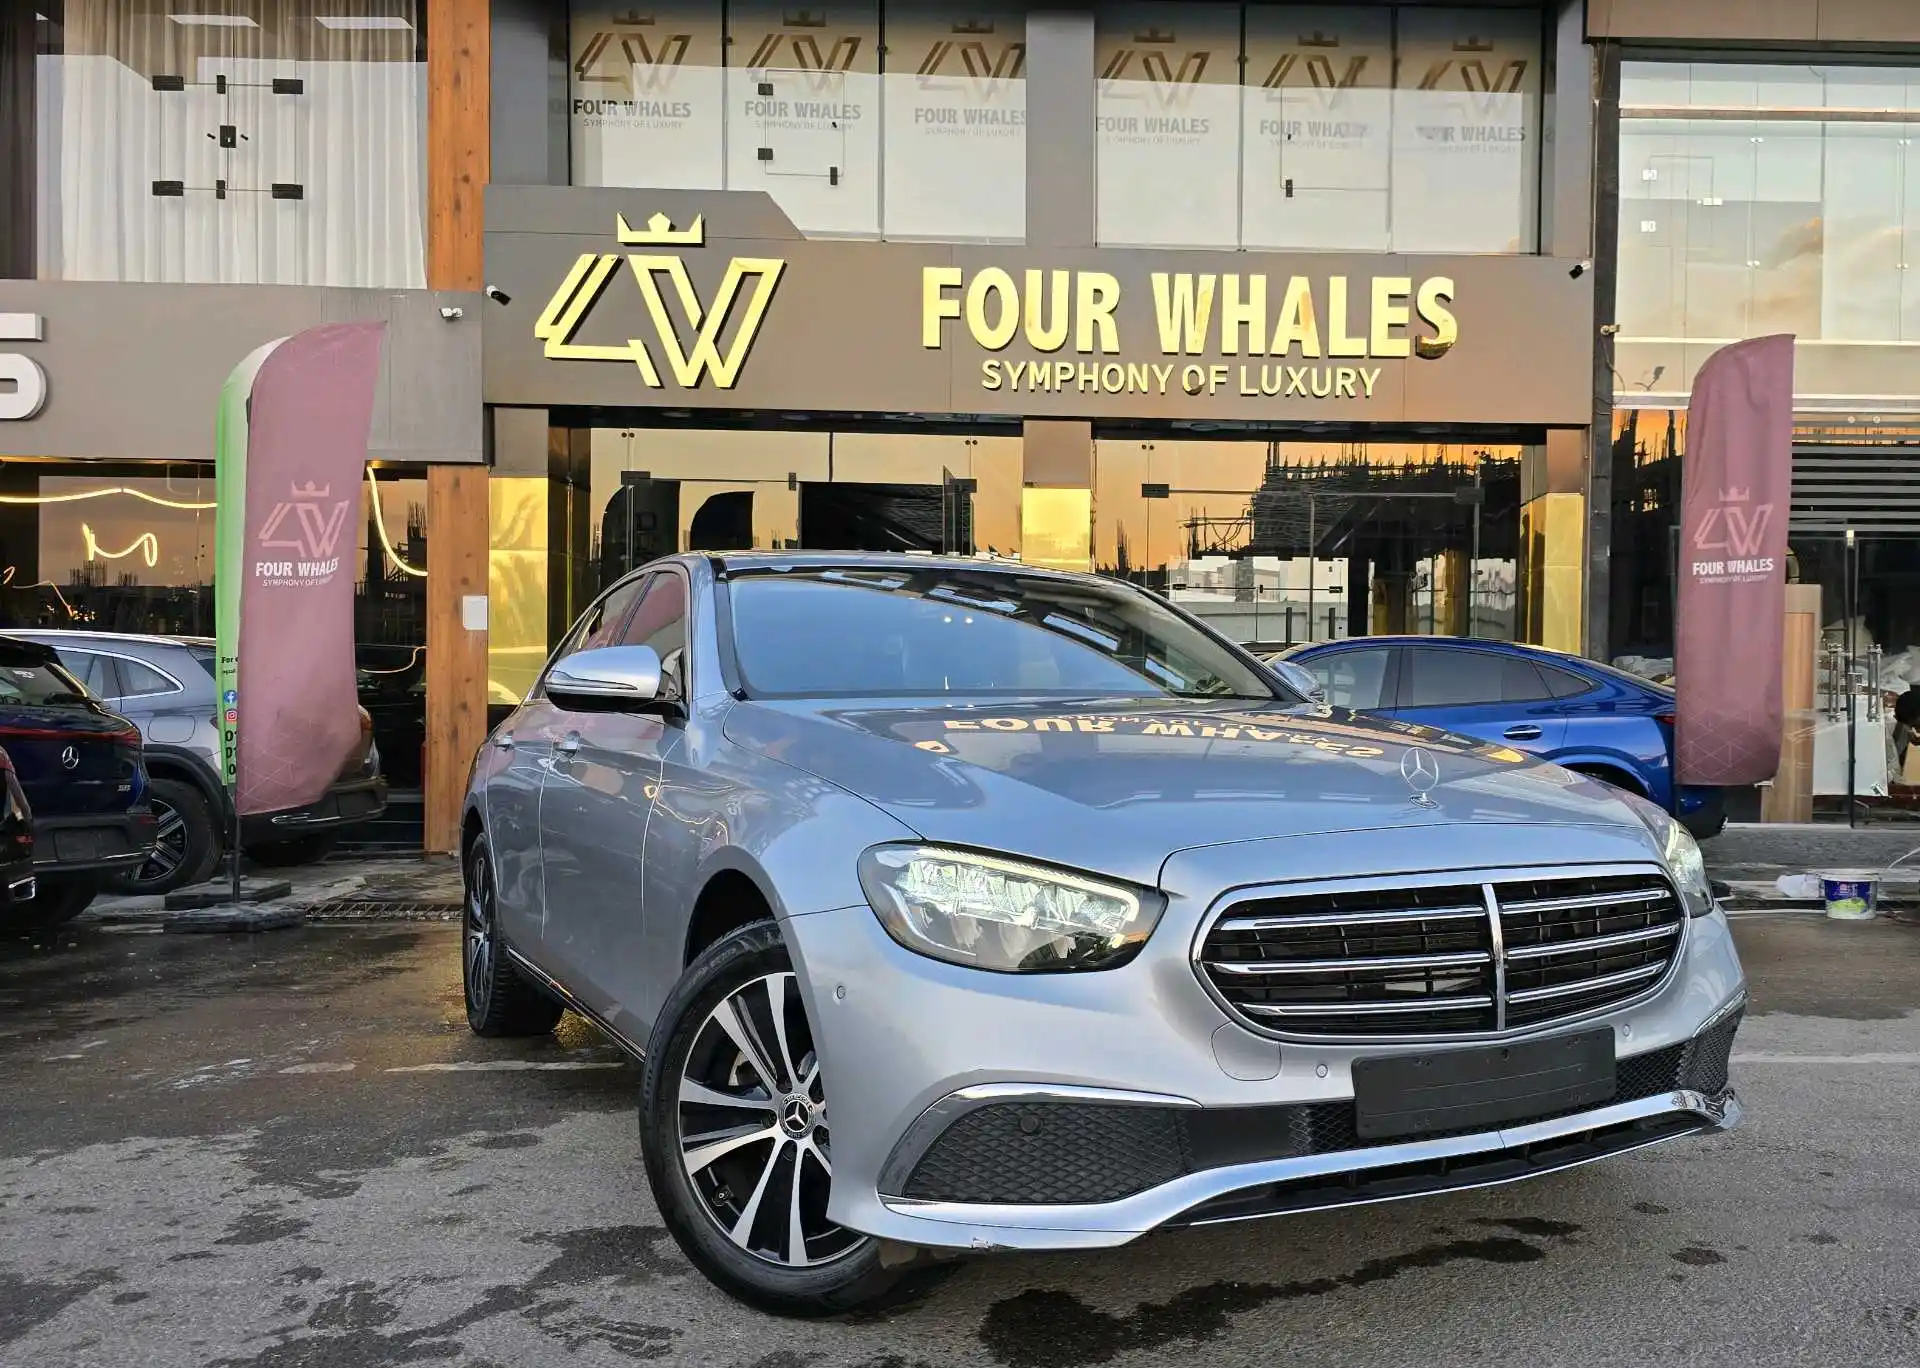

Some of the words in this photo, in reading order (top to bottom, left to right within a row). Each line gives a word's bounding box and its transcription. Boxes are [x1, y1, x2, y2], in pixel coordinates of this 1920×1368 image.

[573, 99, 618, 115] FOUR
[624, 100, 691, 117] WHALES
[744, 101, 788, 117] FOUR
[794, 102, 861, 119] WHALES
[915, 108, 957, 123] FOUR
[1096, 116, 1138, 132] FOUR
[1144, 118, 1209, 133] WHALES
[1260, 120, 1301, 136] FOUR
[1461, 127, 1526, 142] WHALES
[922, 266, 1121, 353] FOUR
[1151, 273, 1458, 359] WHALES
[981, 359, 1174, 396] SYMPHONY
[1182, 365, 1228, 398] OF
[1240, 365, 1382, 400] LUXURY
[256, 561, 292, 577] FOUR
[1692, 561, 1724, 575] FOUR
[1727, 558, 1774, 573] WHALES
[263, 578, 304, 588] SYMPHONY
